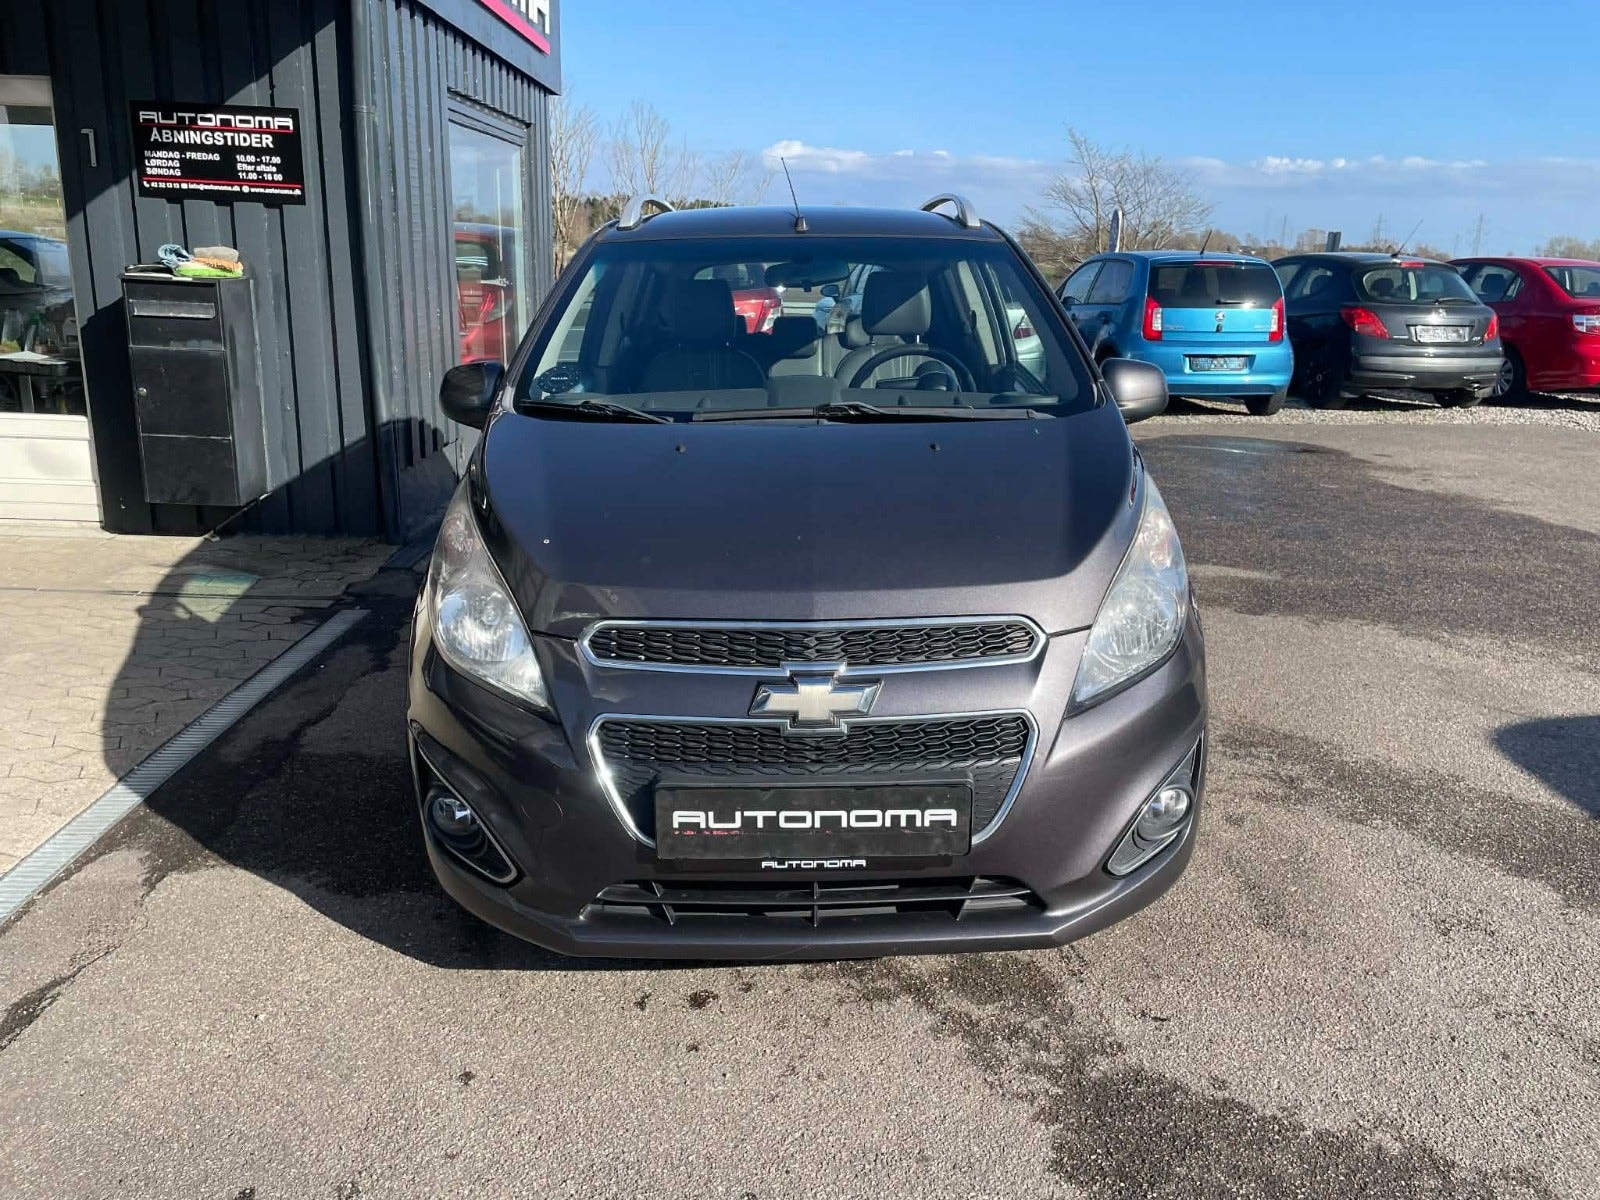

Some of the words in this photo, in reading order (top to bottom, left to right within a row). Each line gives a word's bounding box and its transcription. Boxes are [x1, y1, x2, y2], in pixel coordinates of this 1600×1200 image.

[139, 111, 293, 131] AUTONOMA
[150, 127, 274, 148] ÅBNINGSTIDER
[144, 150, 180, 159] MANDAG
[186, 152, 220, 161] FREDAG
[145, 159, 180, 168] LØRDAG
[146, 167, 181, 176] SØNDAG
[672, 809, 957, 829] AUTONOMA
[761, 859, 866, 869] AUTONOMA
